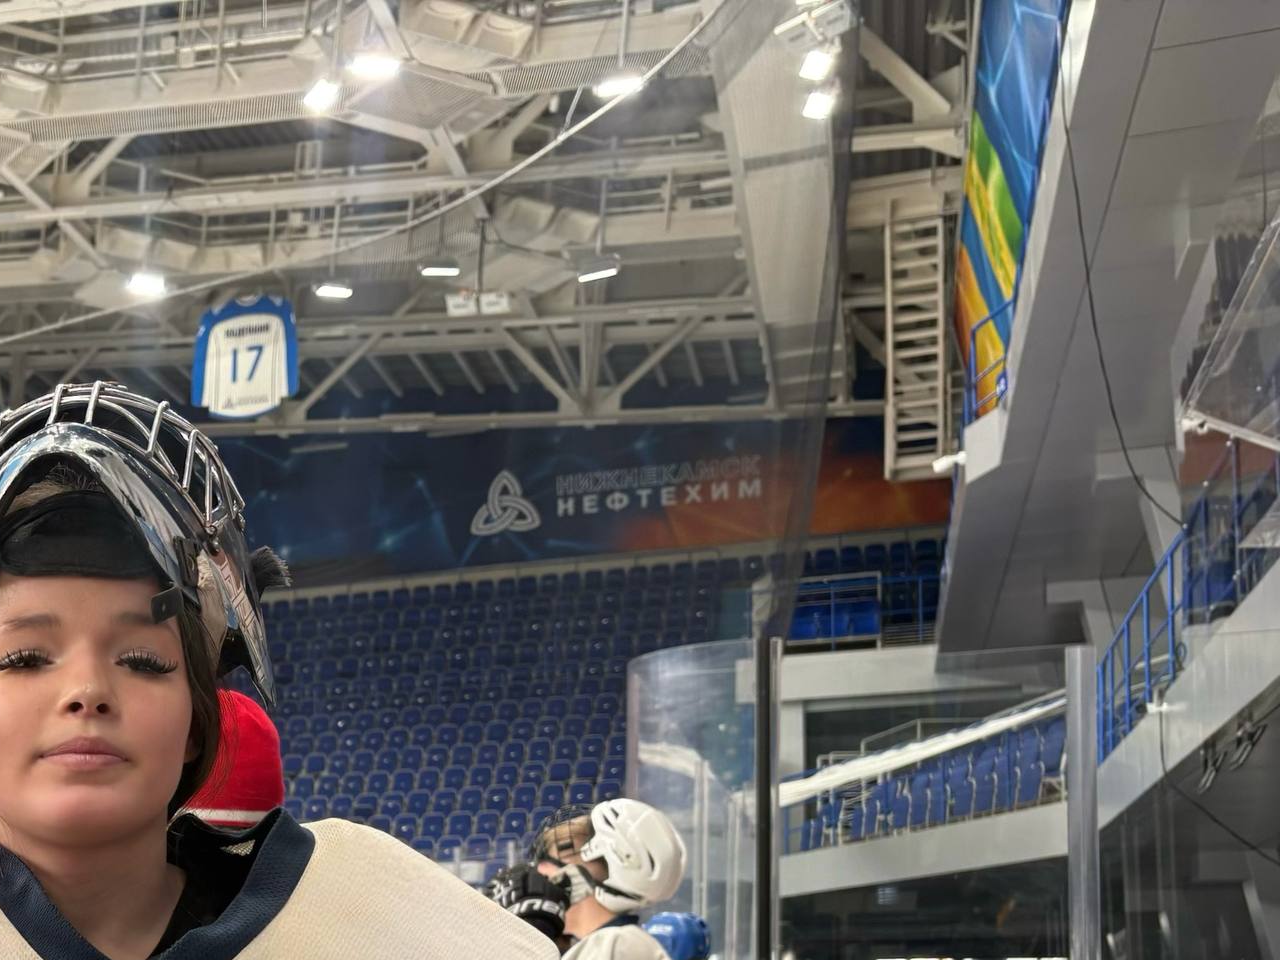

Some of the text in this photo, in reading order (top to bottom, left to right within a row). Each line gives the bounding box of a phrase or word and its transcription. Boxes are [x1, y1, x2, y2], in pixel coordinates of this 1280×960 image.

[231, 345, 264, 383] 17
[556, 455, 761, 495] НИЖНЕКАМСК
[557, 479, 762, 517] НЕФТЕХИМ
